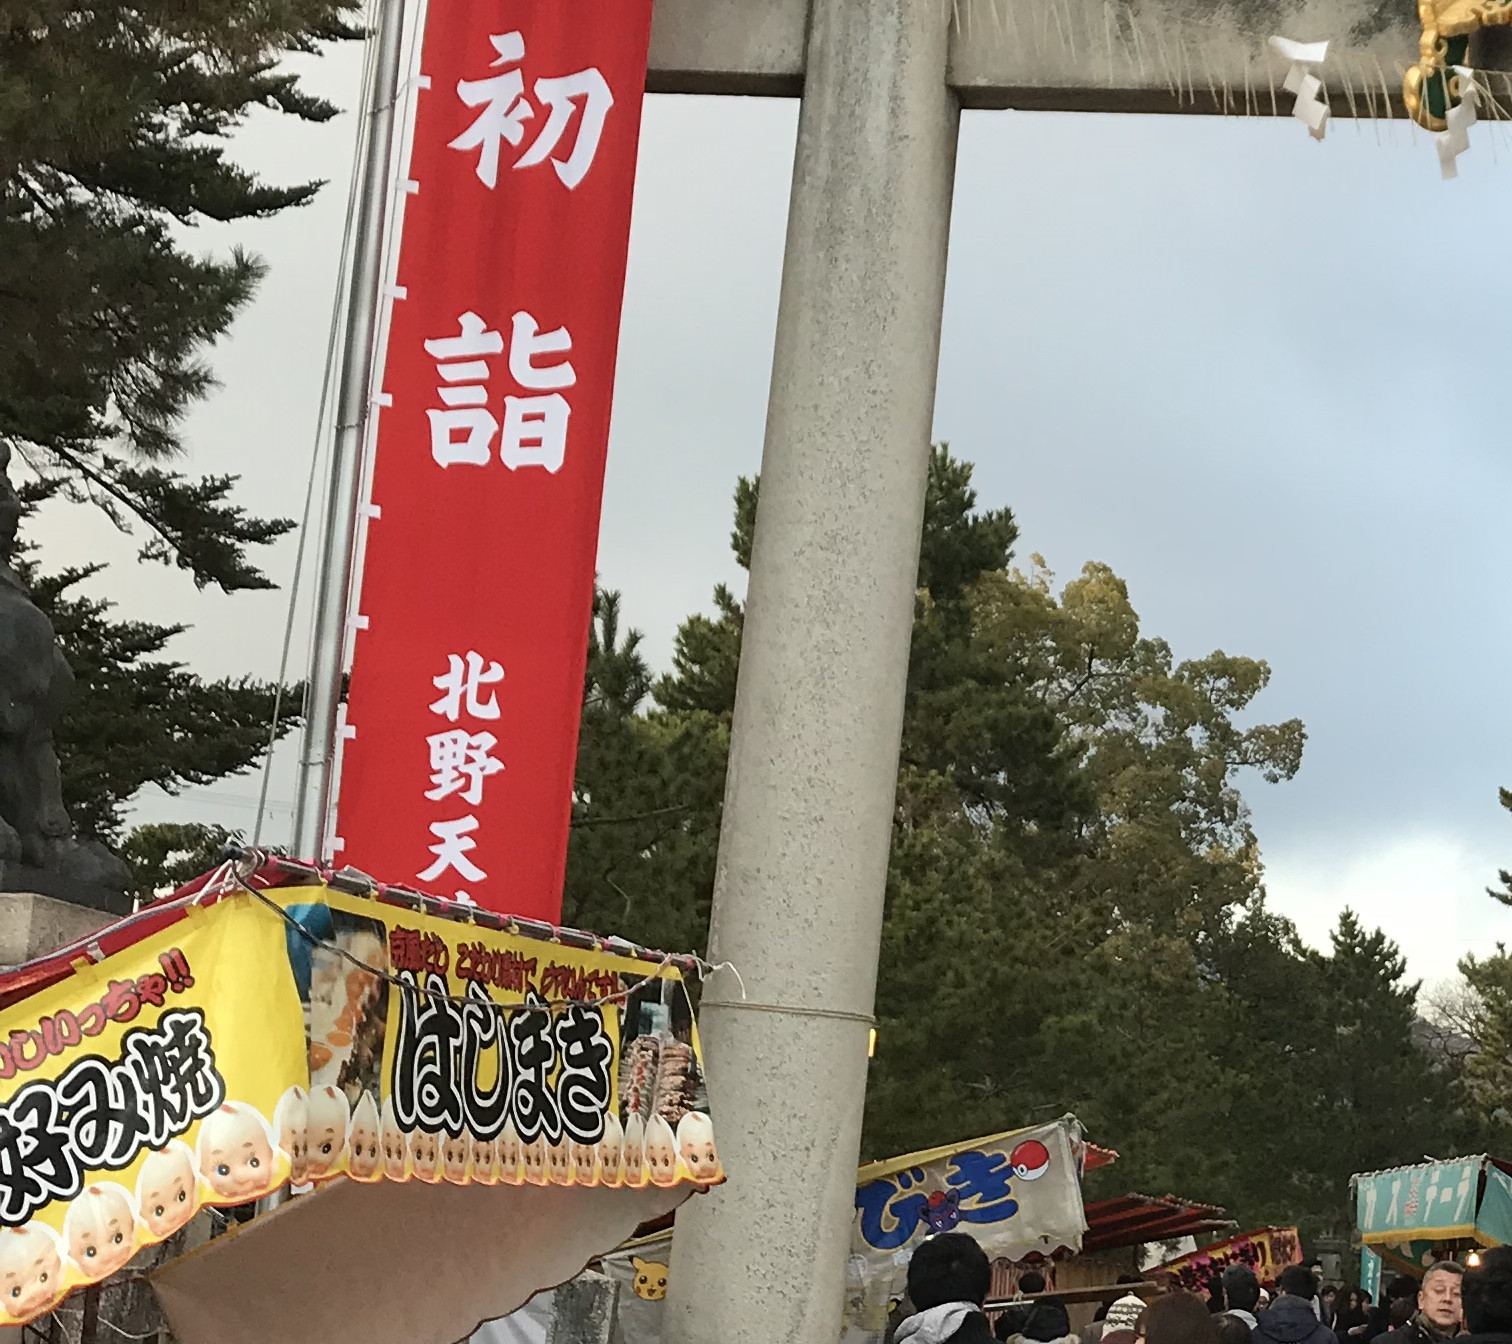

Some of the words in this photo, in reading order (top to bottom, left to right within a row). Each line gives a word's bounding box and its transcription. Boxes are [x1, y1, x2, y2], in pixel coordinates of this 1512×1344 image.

[424, 31, 614, 473] 初詣
[416, 650, 505, 906] 北野天
[392, 967, 613, 1146] はしまき
